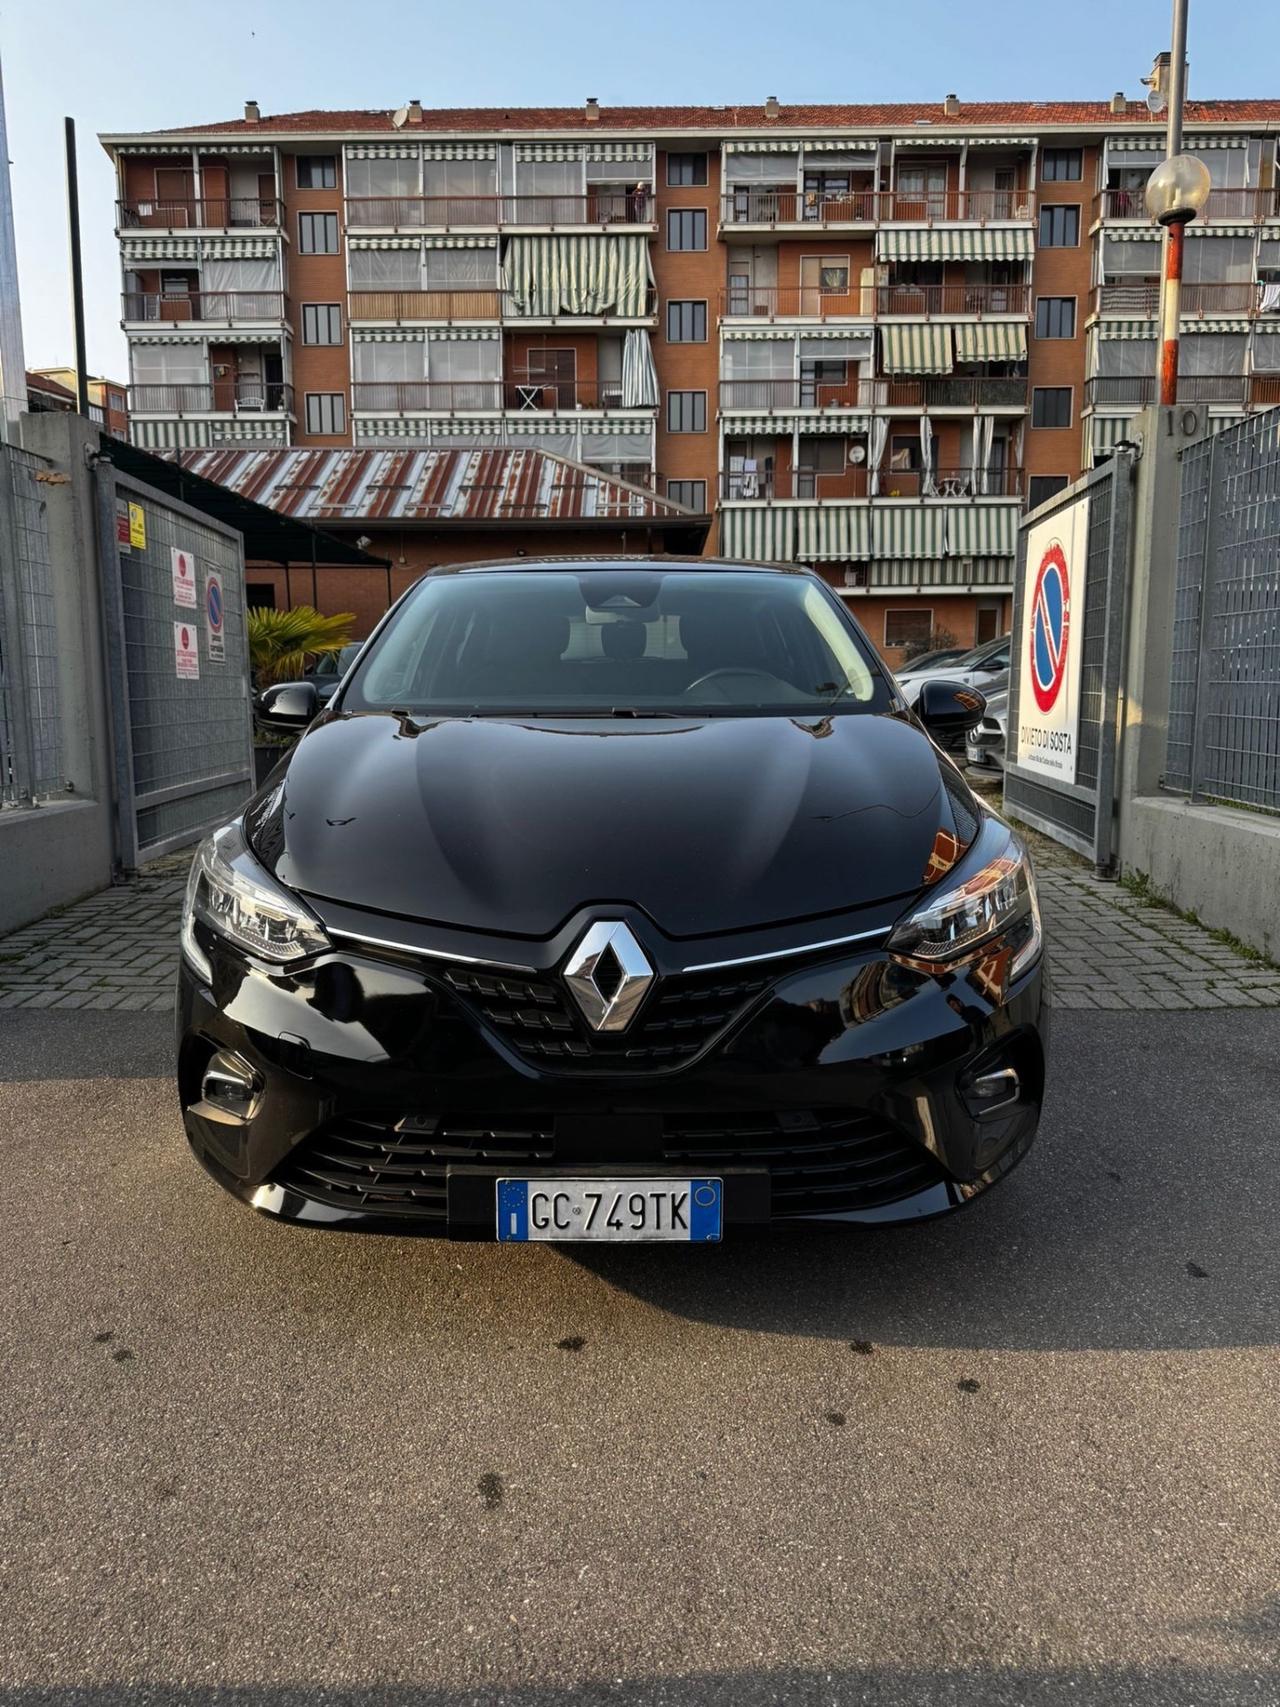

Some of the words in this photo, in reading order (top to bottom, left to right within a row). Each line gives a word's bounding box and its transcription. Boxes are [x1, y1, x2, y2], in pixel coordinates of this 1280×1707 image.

[1167, 410, 1198, 437] 10
[1021, 725, 1043, 748] DIVIETO
[1043, 729, 1050, 750] DI
[1050, 730, 1072, 755] SOSTA
